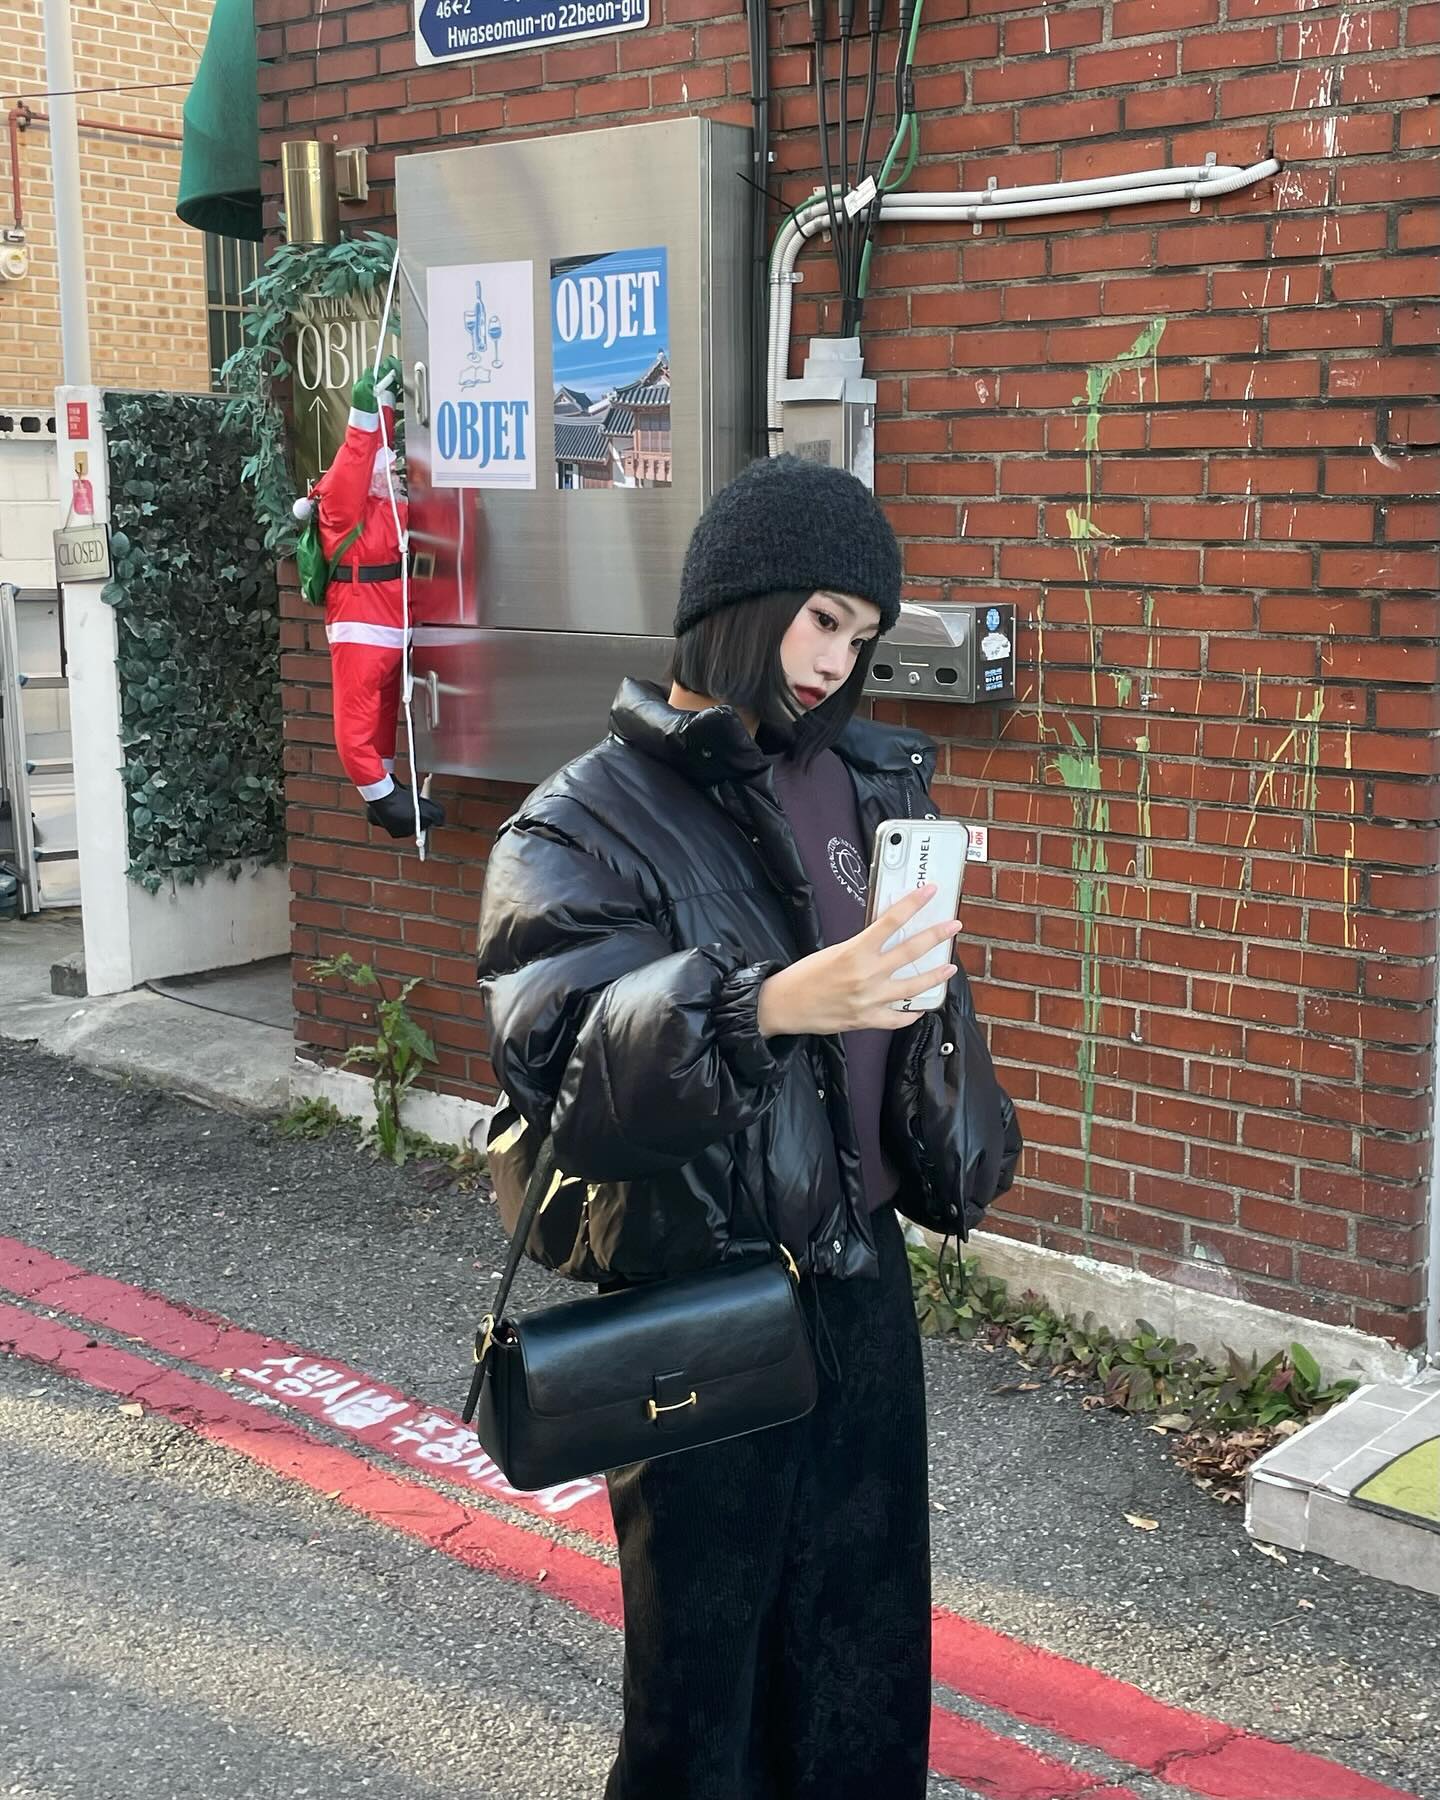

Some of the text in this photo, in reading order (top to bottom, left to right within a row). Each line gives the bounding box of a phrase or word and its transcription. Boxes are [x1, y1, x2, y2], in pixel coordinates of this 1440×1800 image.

[447, 0, 642, 48] Hwaseomun-ro 22beon-gil
[556, 270, 660, 349] OBJET
[437, 400, 529, 469] OBJET
[58, 540, 104, 567] CLOSED
[916, 836, 931, 889] CHANEL
